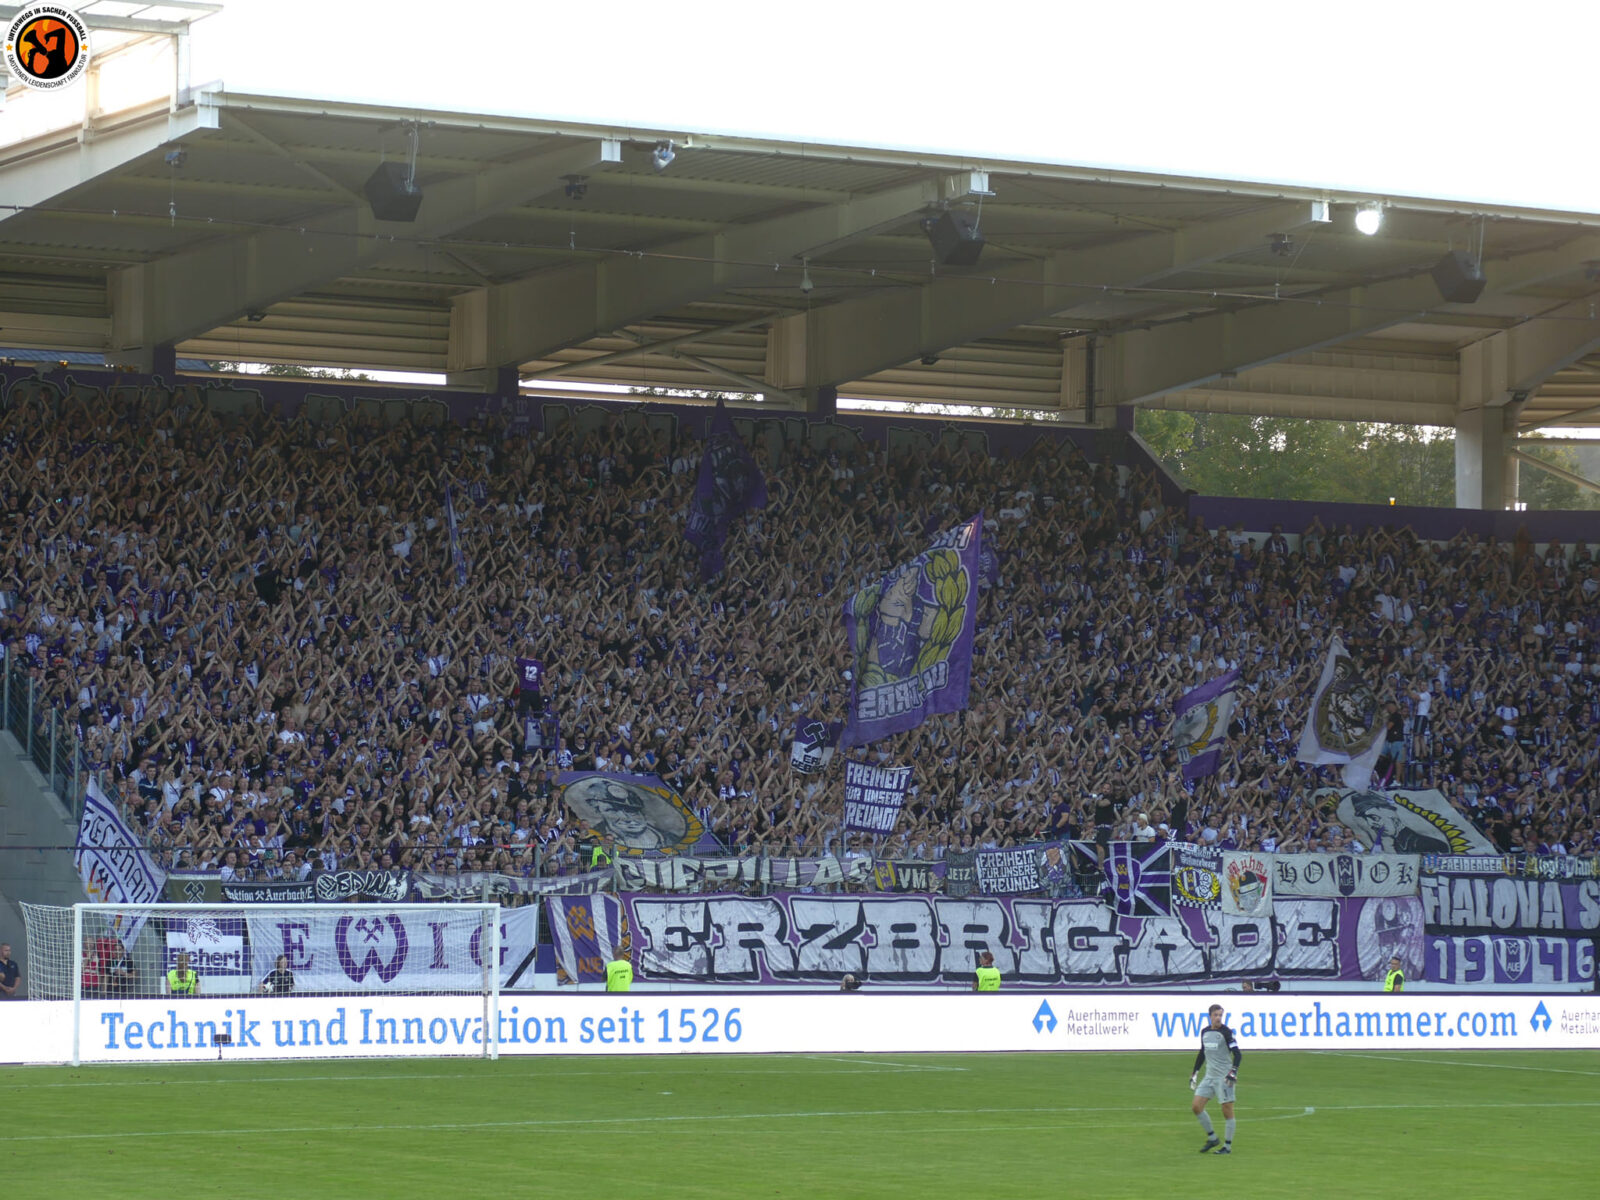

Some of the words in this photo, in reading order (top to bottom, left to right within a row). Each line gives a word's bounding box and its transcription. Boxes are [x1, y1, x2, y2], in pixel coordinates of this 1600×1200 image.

[525, 665, 538, 681] 12
[846, 762, 910, 790] FREIHEIT
[845, 801, 900, 832] REUND
[978, 849, 1036, 868] FREIHEIT
[981, 875, 1040, 894] FREUNDE
[633, 897, 1343, 980] ERZBRIGADE
[168, 947, 241, 969] Echert
[1068, 1009, 1139, 1022] Auerhammer
[101, 1008, 261, 1050] Technik
[272, 1008, 348, 1046] und
[360, 1006, 568, 1045] Innovation
[579, 1006, 645, 1044] seit
[656, 1007, 743, 1043] 1526
[1067, 1023, 1129, 1036] Metallwerk
